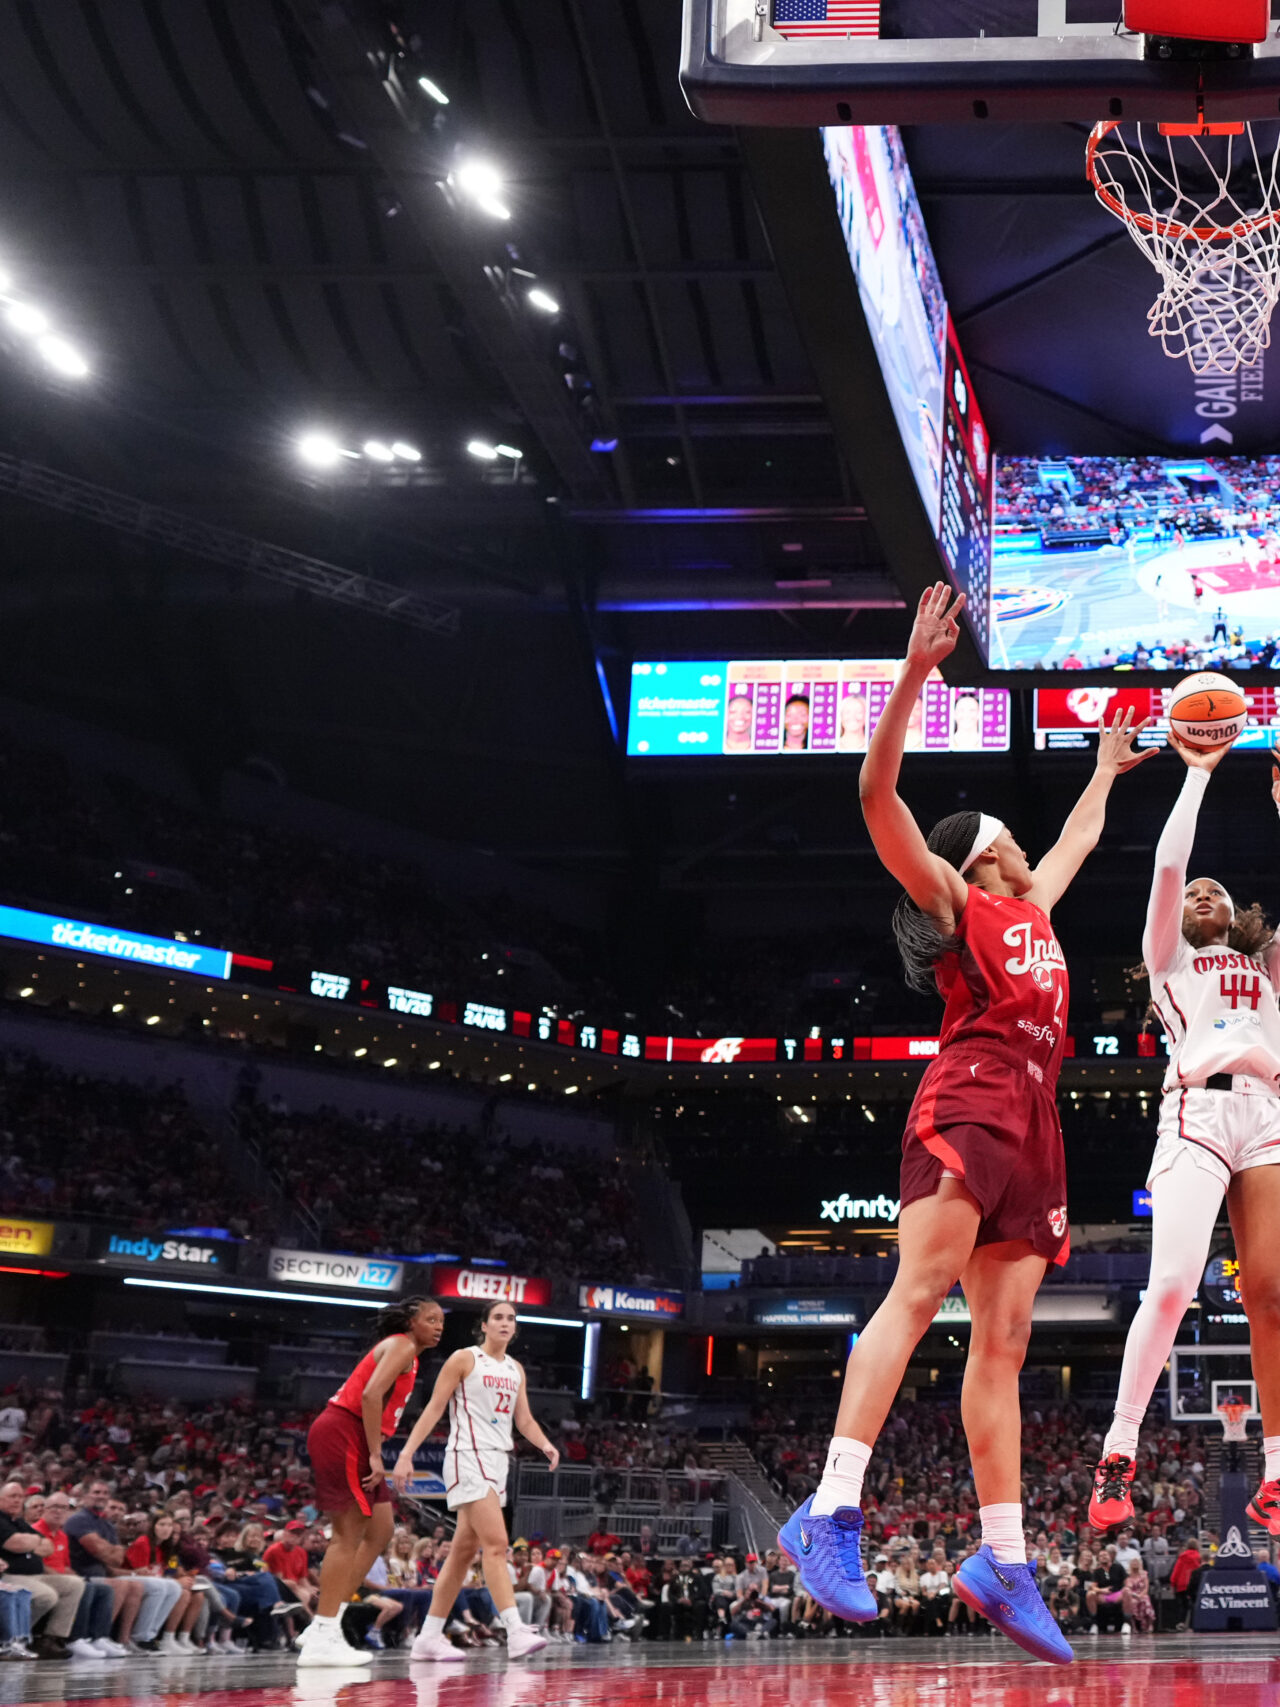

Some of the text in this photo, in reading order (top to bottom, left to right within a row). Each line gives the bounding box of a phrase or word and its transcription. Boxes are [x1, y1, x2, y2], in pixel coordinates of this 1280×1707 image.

[1187, 722, 1238, 741] Wilson
[51, 921, 202, 971] ticketmaster
[310, 979, 349, 999] 6/27
[1219, 973, 1263, 1011] 44
[832, 1046, 843, 1059] 3
[908, 1040, 940, 1056] INDI
[1093, 1036, 1119, 1055] 72
[820, 1193, 900, 1223] xfinity
[271, 1255, 393, 1284] SECTION 127
[494, 1392, 511, 1414] 22
[1200, 1582, 1267, 1595] Ascension
[1200, 1596, 1270, 1610] St. Vincent
